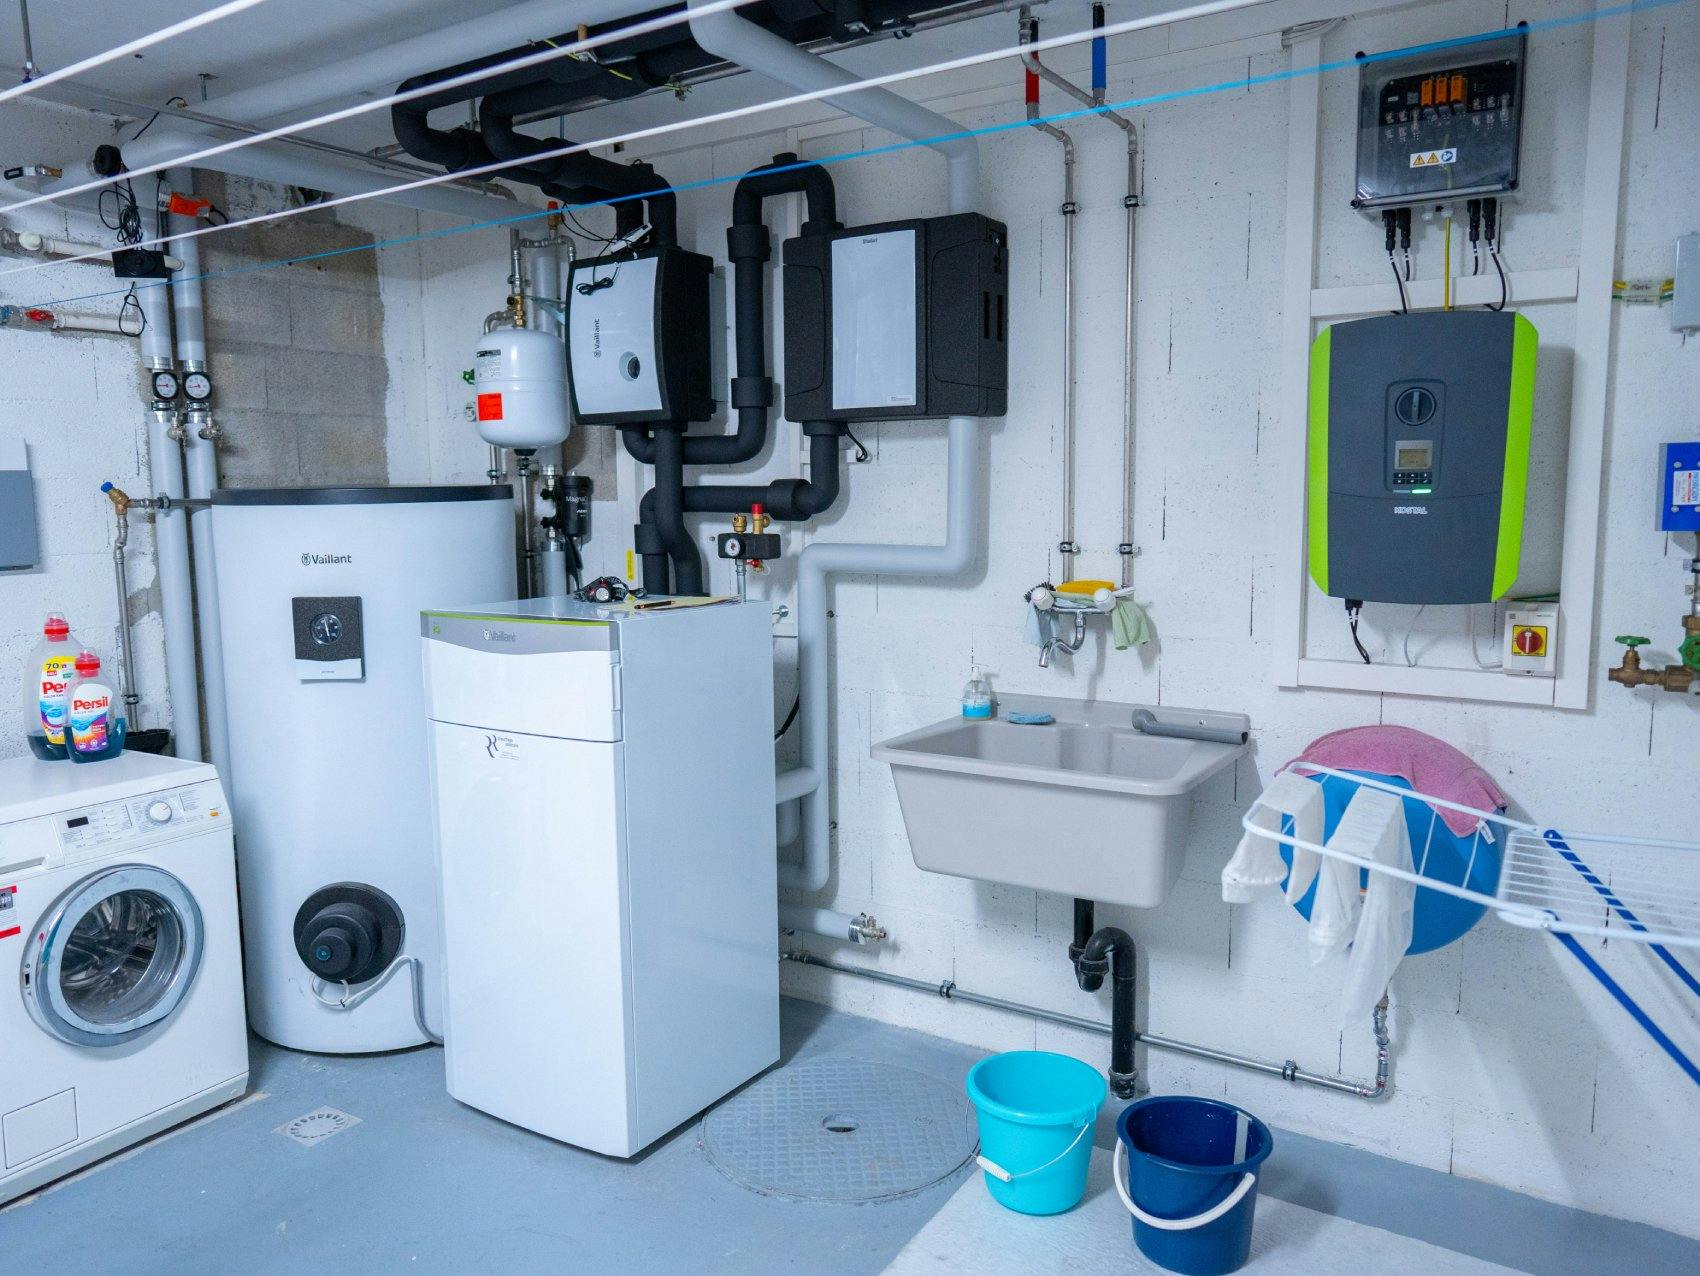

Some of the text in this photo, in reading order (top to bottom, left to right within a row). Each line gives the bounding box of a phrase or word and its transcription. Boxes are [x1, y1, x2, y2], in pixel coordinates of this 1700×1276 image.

[311, 554, 352, 564] Vaillant
[490, 630, 516, 642] Vaillant
[73, 696, 108, 711] Persil
